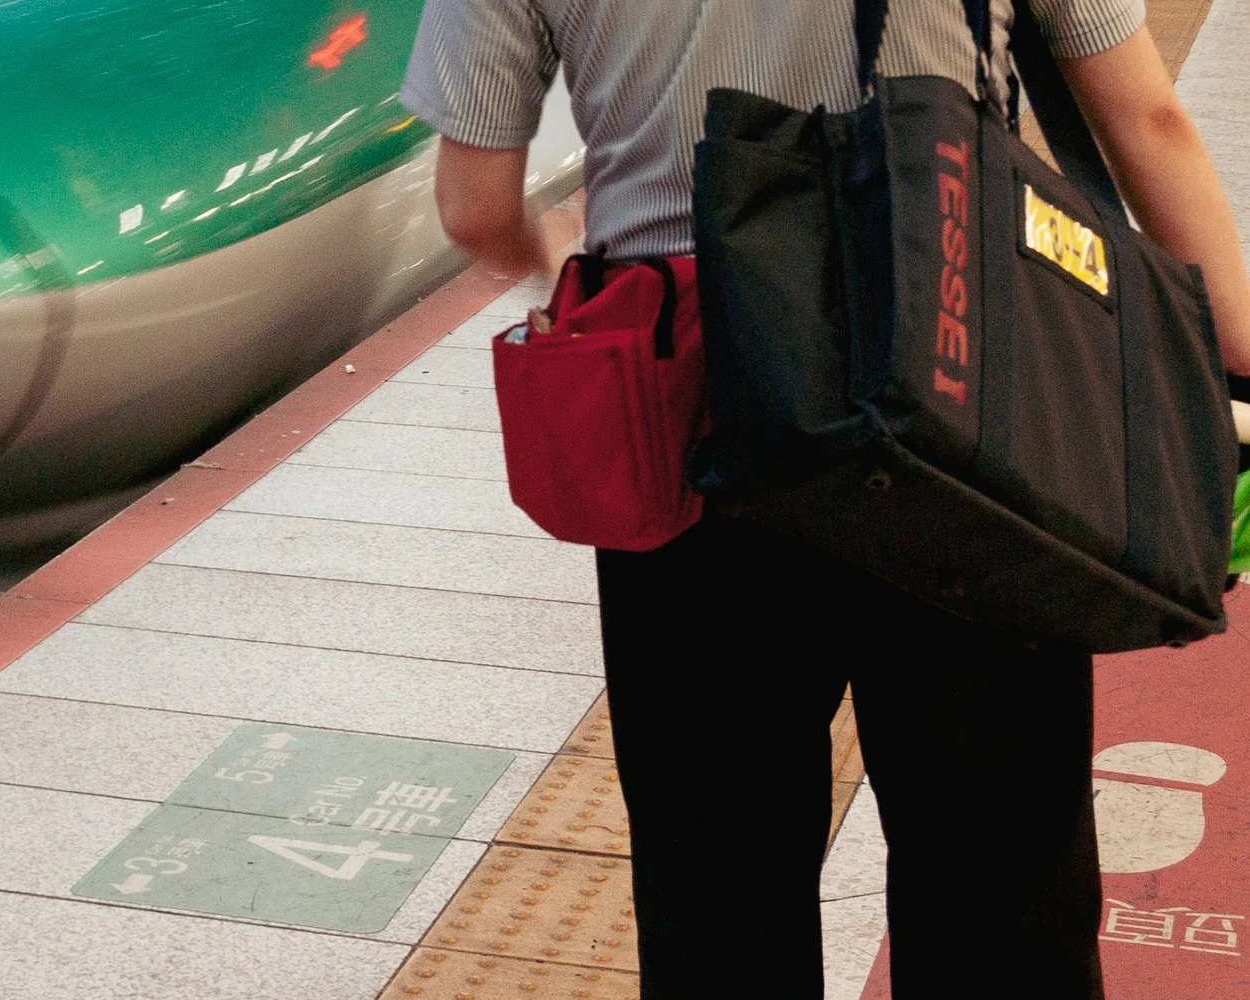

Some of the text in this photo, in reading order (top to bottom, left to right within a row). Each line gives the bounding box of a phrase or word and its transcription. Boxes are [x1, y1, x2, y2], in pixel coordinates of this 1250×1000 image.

[934, 141, 970, 405] TESSEI
[289, 776, 367, 827] Car No.
